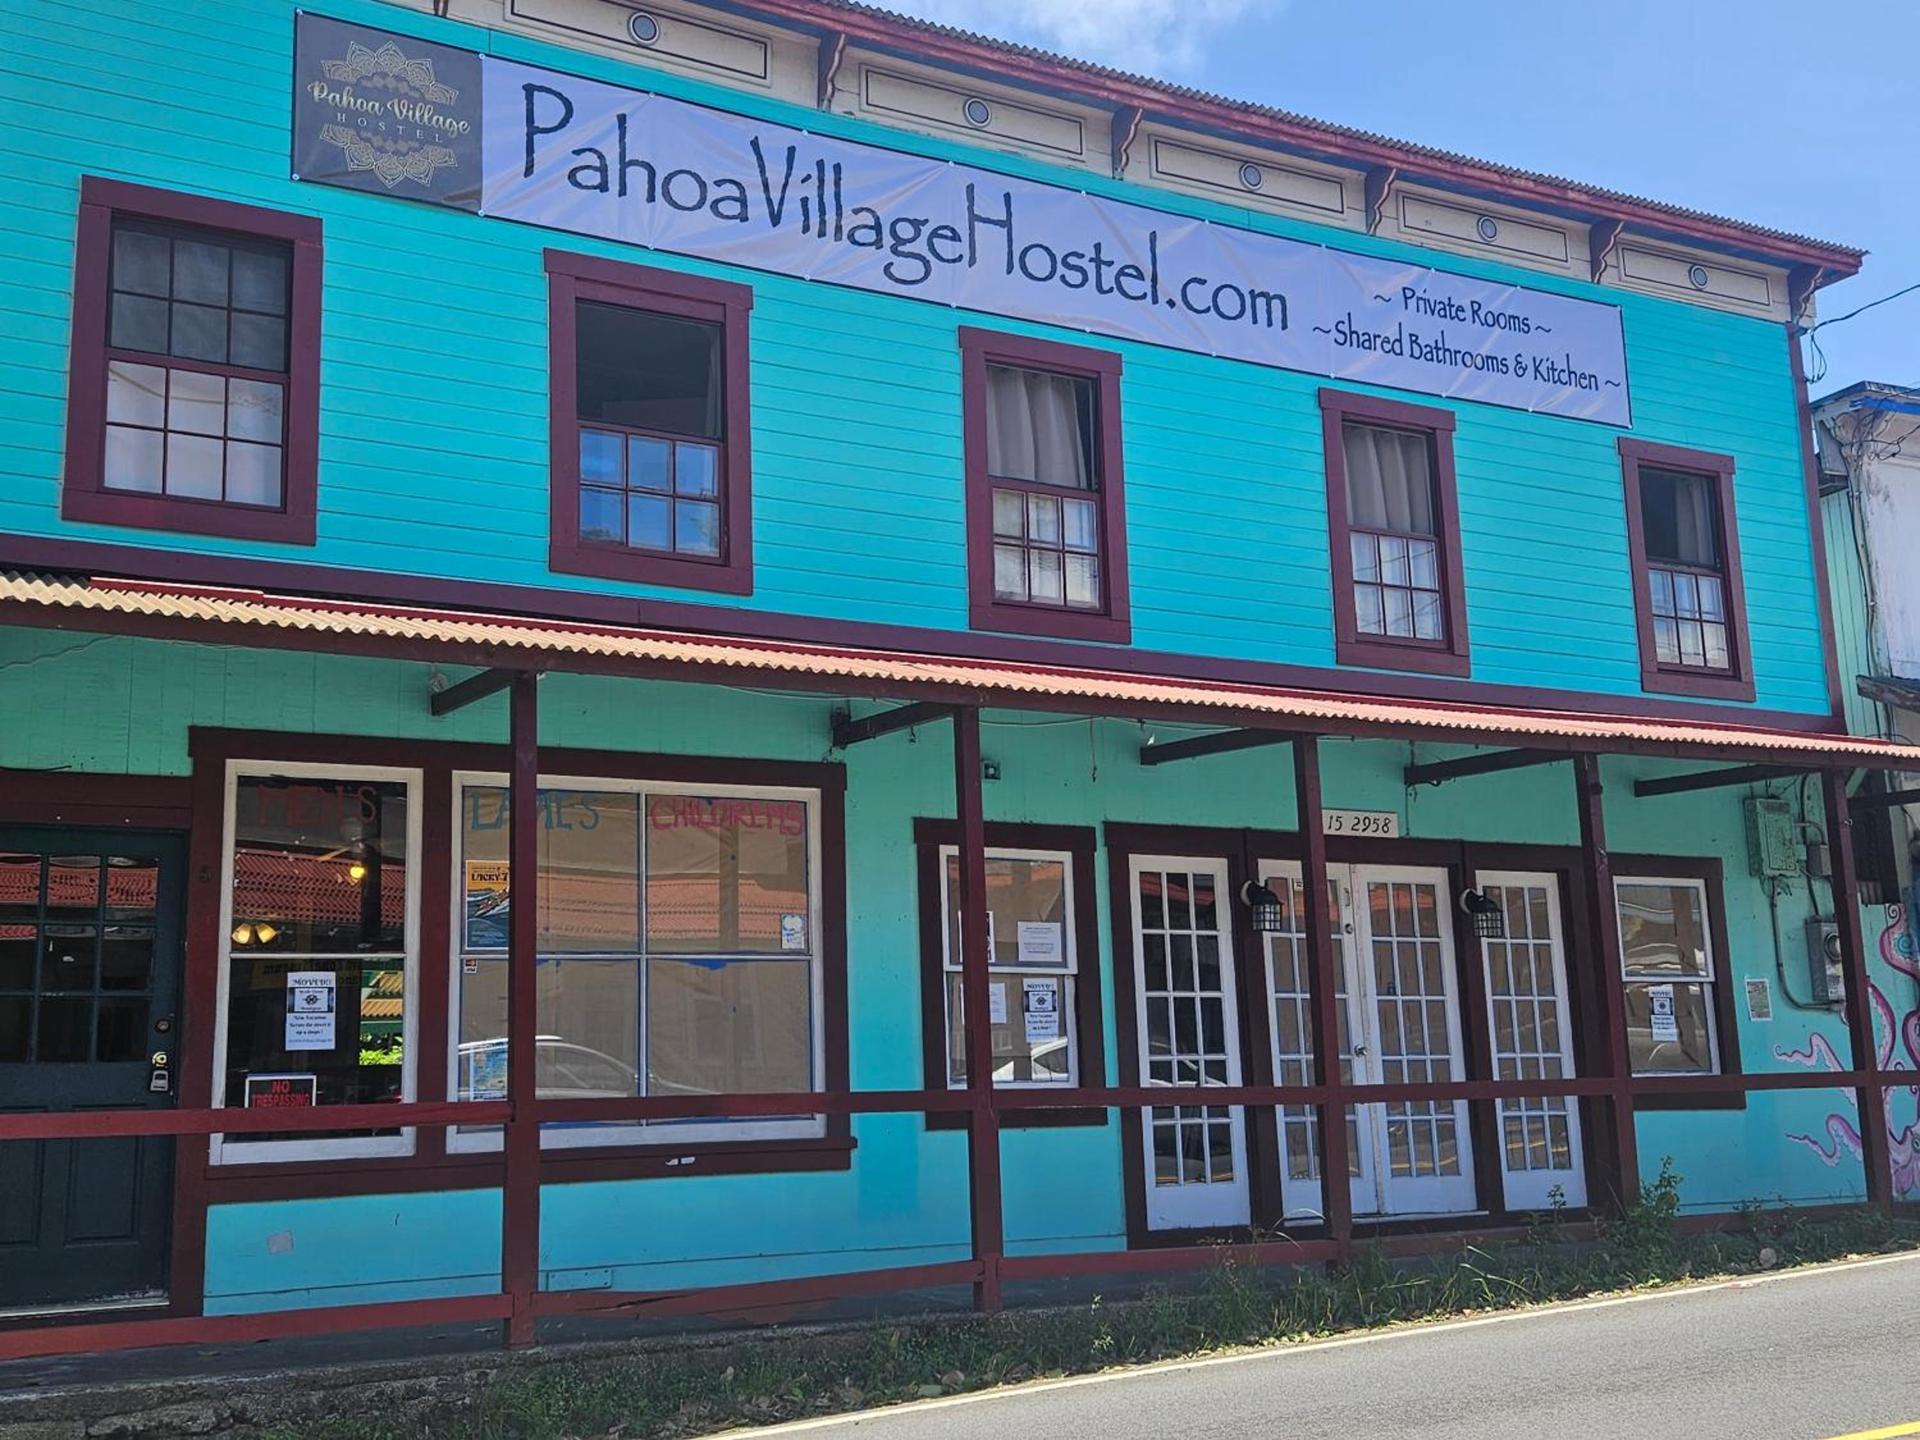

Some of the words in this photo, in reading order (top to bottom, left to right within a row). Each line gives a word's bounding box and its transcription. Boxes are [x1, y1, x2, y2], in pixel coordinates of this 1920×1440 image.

[307, 80, 384, 117] Pahoa
[387, 98, 471, 138] Village
[336, 112, 443, 144] HOSTEL
[522, 83, 1289, 331] PahoaVillageHostel.com
[1402, 286, 1467, 322] Private
[1470, 300, 1531, 335] Rooms
[1409, 330, 1509, 376] Bathrooms
[1514, 353, 1529, 378] &
[1532, 353, 1599, 392] Kitchen
[1327, 814, 1343, 832] 15
[1350, 815, 1392, 834] 2958
[271, 1081, 290, 1094] NO
